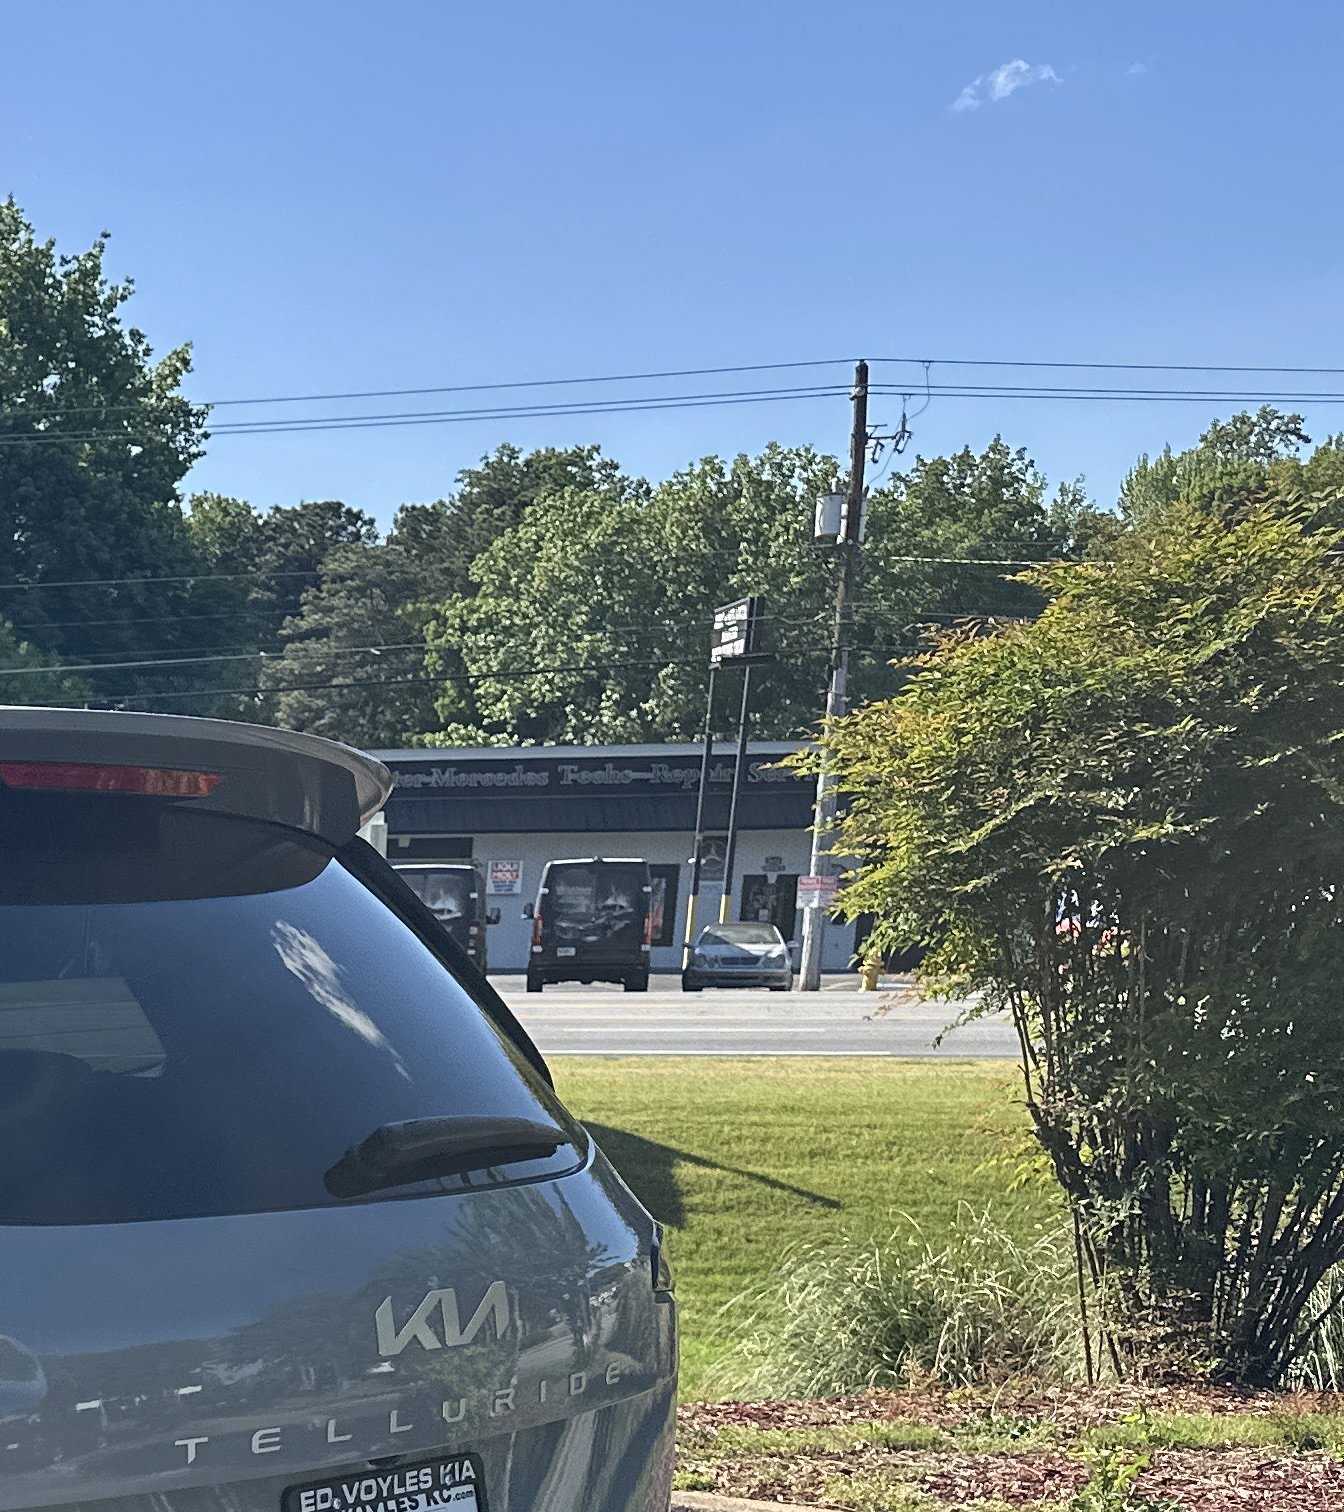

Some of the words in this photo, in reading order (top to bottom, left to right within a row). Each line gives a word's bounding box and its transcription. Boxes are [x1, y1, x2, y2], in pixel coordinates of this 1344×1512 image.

[375, 1280, 510, 1357] KIA
[174, 1362, 620, 1464] TELLURIDE
[342, 1467, 432, 1504] VOYLES
[439, 1459, 476, 1487] KIA
